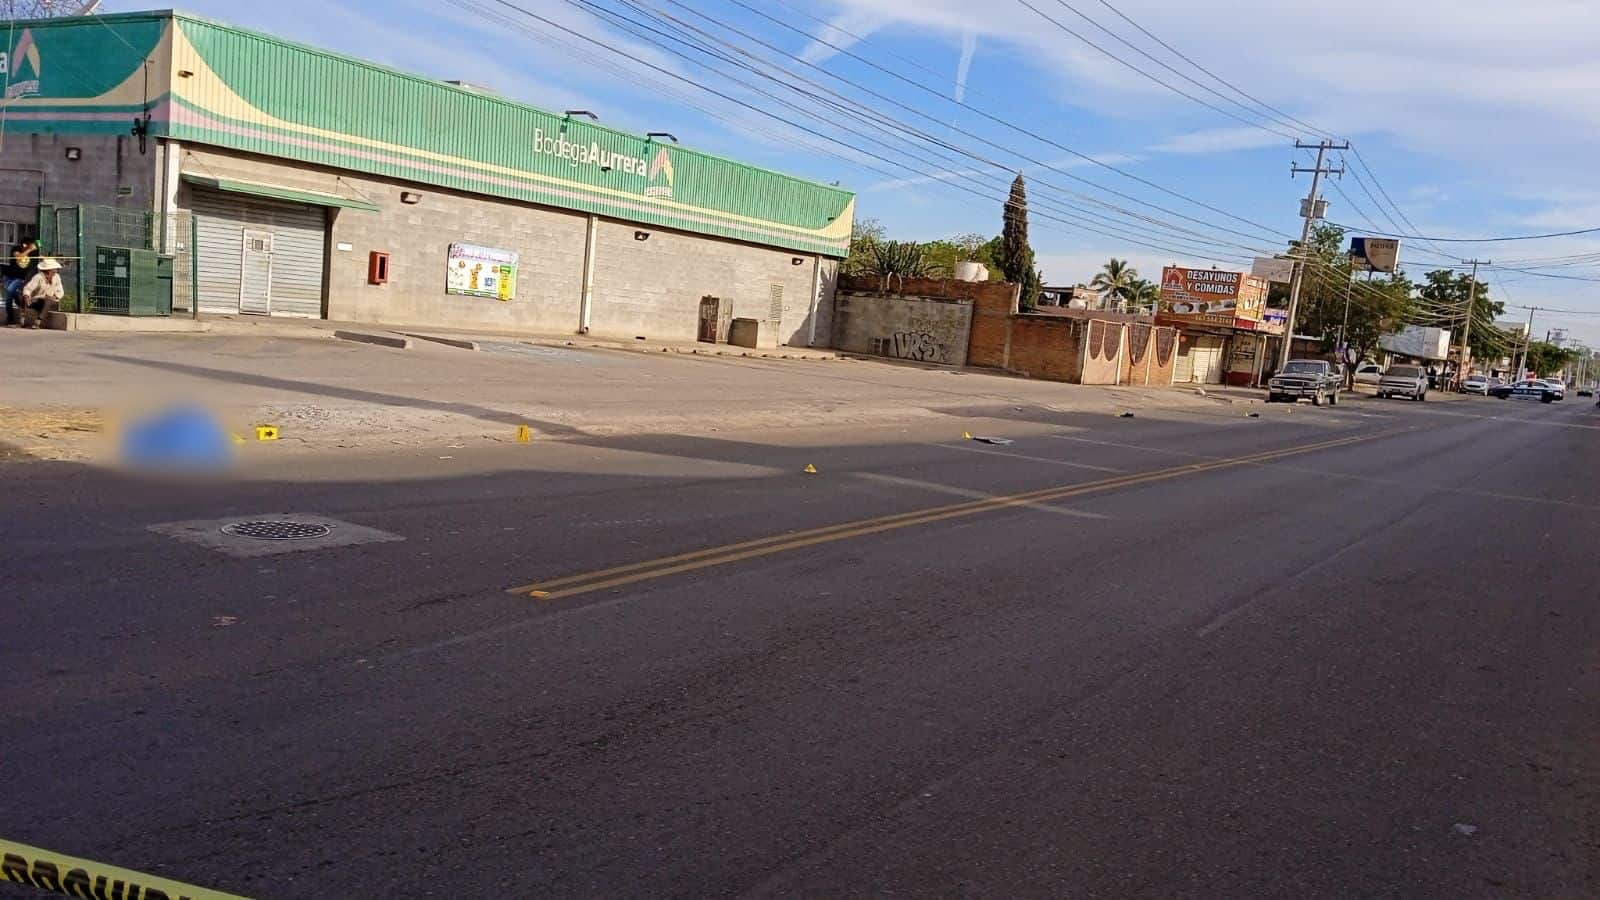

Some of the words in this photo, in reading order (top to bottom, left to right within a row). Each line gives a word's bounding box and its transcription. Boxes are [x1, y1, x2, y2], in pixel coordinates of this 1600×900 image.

[1187, 270, 1238, 283] DESAYUNOS
[1187, 281, 1193, 291] Y
[1195, 282, 1234, 295] COMIDAS
